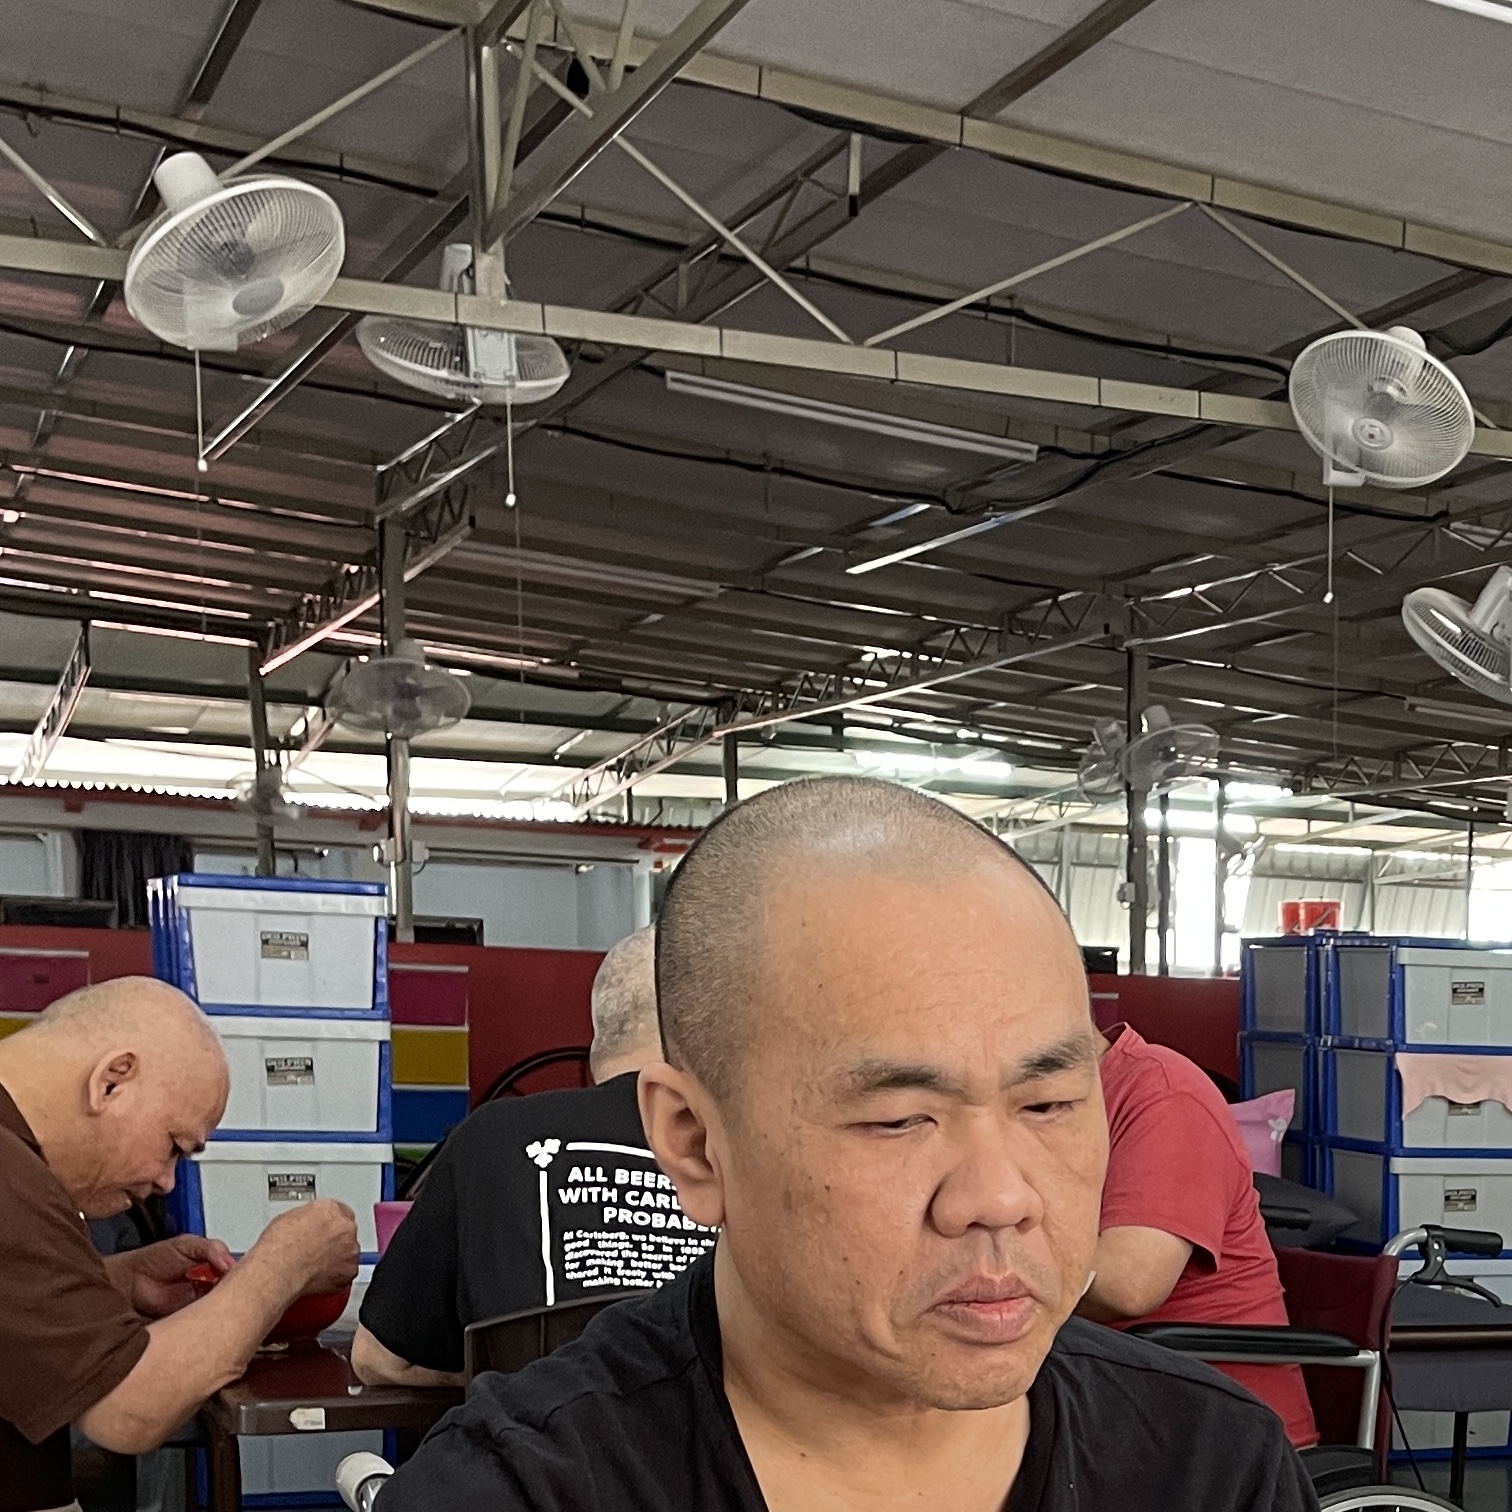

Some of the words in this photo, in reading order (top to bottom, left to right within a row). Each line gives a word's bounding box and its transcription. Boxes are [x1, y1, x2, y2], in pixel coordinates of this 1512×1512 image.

[568, 1167, 608, 1182] ALL
[614, 1168, 677, 1190] BEER
[558, 1187, 618, 1204] WITH
[625, 1191, 681, 1210] CARL
